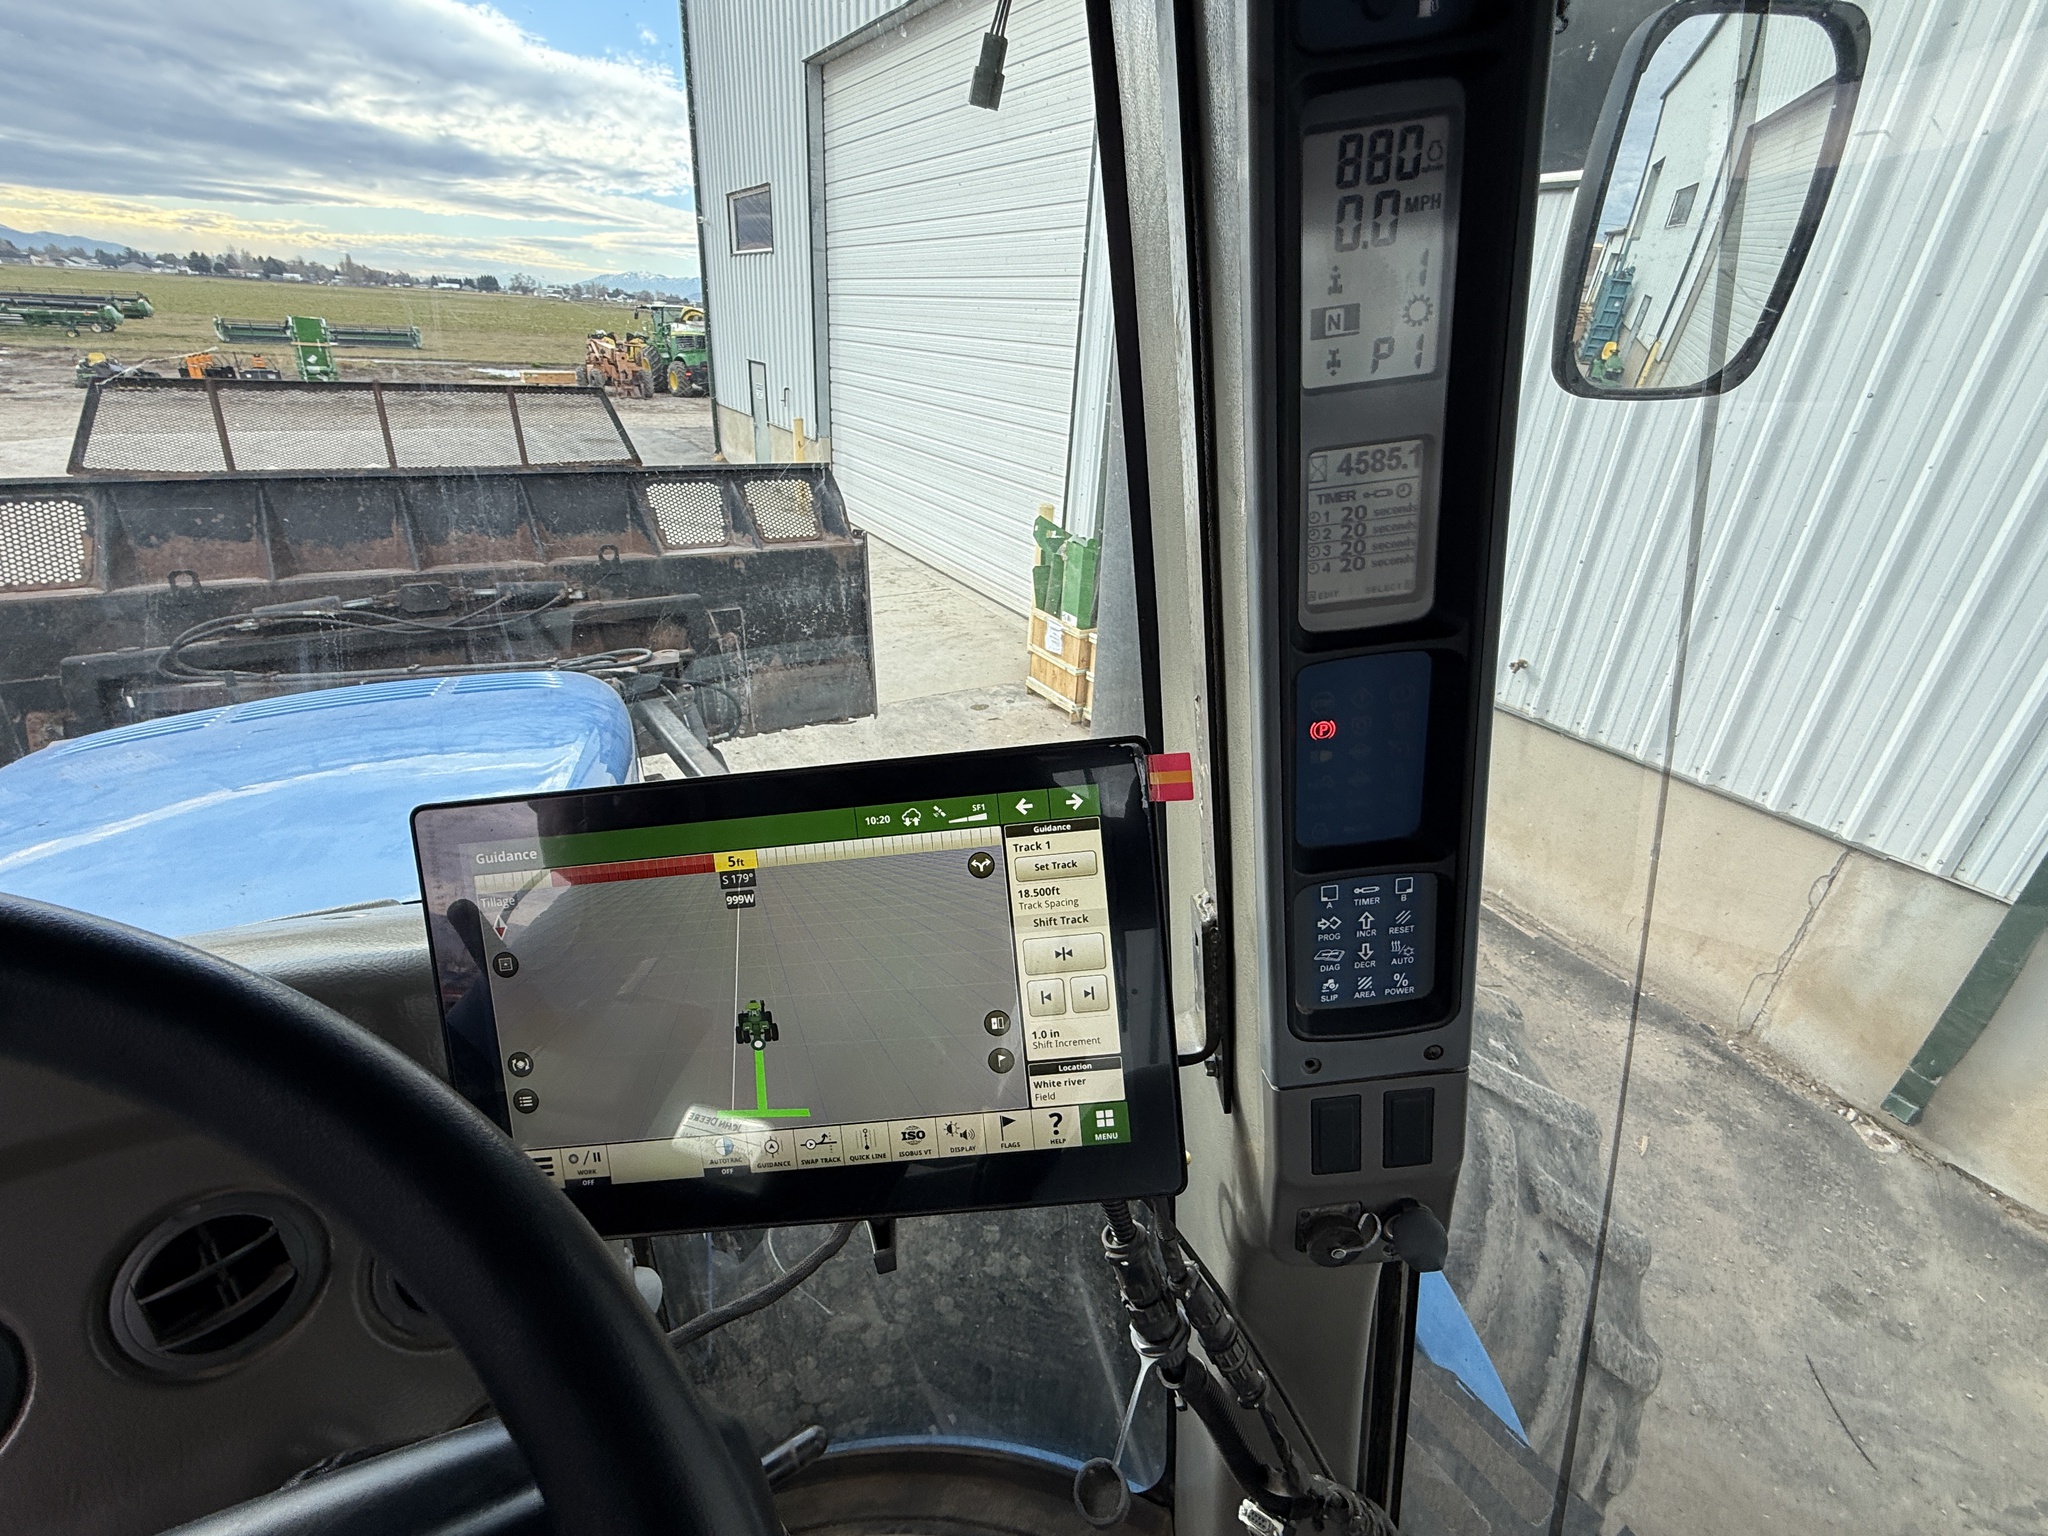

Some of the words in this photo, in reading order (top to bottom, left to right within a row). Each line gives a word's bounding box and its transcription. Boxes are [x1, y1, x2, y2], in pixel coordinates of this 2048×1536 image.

[1336, 124, 1424, 189] 880
[1335, 189, 1400, 252] 0.0
[1404, 193, 1441, 213] MPH
[1327, 312, 1341, 332] N
[1371, 336, 1395, 374] P
[1337, 445, 1422, 477] 4585.1
[1316, 490, 1356, 505] TIMER
[1323, 511, 1330, 522] 1
[1341, 505, 1367, 522] 20
[1323, 528, 1332, 540] 2
[1340, 522, 1366, 539] 20
[1323, 545, 1331, 557] 3
[1340, 539, 1366, 557] 20
[1322, 562, 1331, 573] 4
[1339, 556, 1366, 573] 20
[972, 803, 986, 812] SF1
[865, 815, 891, 826] 10:20
[1033, 822, 1071, 834] Guidance
[1013, 841, 1042, 853] Track
[1045, 841, 1051, 850] 1
[476, 849, 538, 865] Guidance
[727, 856, 745, 868] 5ft
[1034, 862, 1049, 872] Set
[1051, 859, 1078, 870] Track
[722, 875, 729, 885] S
[1018, 886, 1061, 898] 18.500ft
[480, 895, 516, 909] Tillage
[726, 893, 755, 906] 999W
[1019, 900, 1043, 910] Track
[1045, 897, 1080, 909] Spacing
[1354, 897, 1380, 906] TIMER
[1033, 916, 1058, 928] Shift
[1061, 914, 1089, 925] Track
[1356, 929, 1377, 937] INCR
[1389, 925, 1415, 935] RESET
[1318, 933, 1341, 941] PROG
[1354, 960, 1376, 969] DECR
[1391, 956, 1414, 965] AUTO
[1320, 963, 1340, 972] DIAG
[1354, 990, 1376, 999] AREA
[1385, 986, 1415, 996] POWER
[1320, 994, 1339, 1002] SLIP
[1032, 1030, 1047, 1040] 1.0
[1050, 1029, 1060, 1039] in
[1033, 1040, 1053, 1050] Shift
[1055, 1036, 1101, 1048] Increment
[1058, 1062, 1093, 1072] Location
[1033, 1079, 1063, 1089] White
[1064, 1077, 1087, 1087] river
[1035, 1092, 1056, 1101] Field
[901, 1129, 926, 1141] ISO
[1095, 1132, 1119, 1141] MENU
[950, 1145, 976, 1153] DISPLAY
[1000, 1141, 1021, 1149] FLAGS
[850, 1154, 869, 1162] QUICK
[870, 1152, 887, 1160] LINE
[899, 1149, 922, 1158] ISOBUS
[924, 1148, 932, 1156] VT
[709, 1156, 743, 1166] AUTOTRAC
[757, 1160, 792, 1169] GUIDANCE
[801, 1158, 818, 1166] SWAP
[820, 1156, 842, 1164] TRACK
[577, 1168, 598, 1176] WORK
